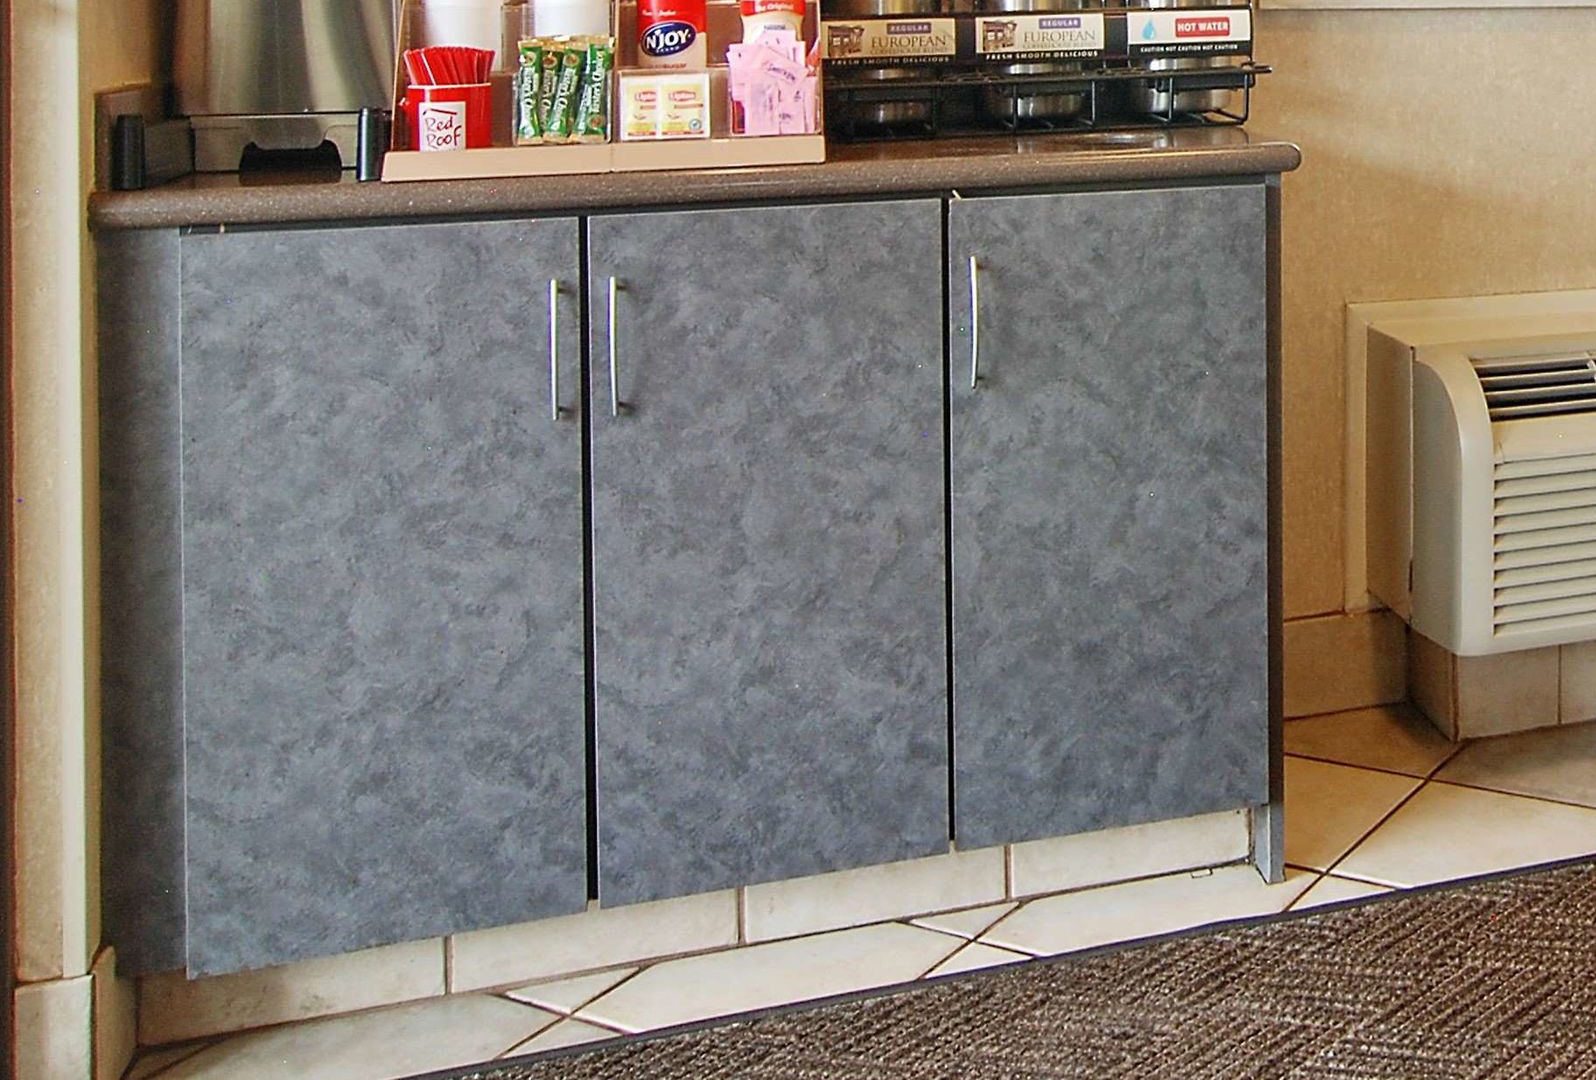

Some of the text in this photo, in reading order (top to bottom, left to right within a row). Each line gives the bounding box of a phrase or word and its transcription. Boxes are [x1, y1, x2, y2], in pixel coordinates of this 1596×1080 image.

[890, 24, 929, 32] REGULAR
[1042, 19, 1079, 27] REGULAR
[1177, 21, 1229, 32] HOT WATER
[872, 35, 946, 48] EUROPEAN
[1024, 30, 1096, 42] EUROPEAN
[1053, 50, 1099, 58] DELICIOUS
[903, 56, 950, 64] DELICIOUS
[425, 116, 454, 132] Red
[426, 125, 462, 149] Roof
